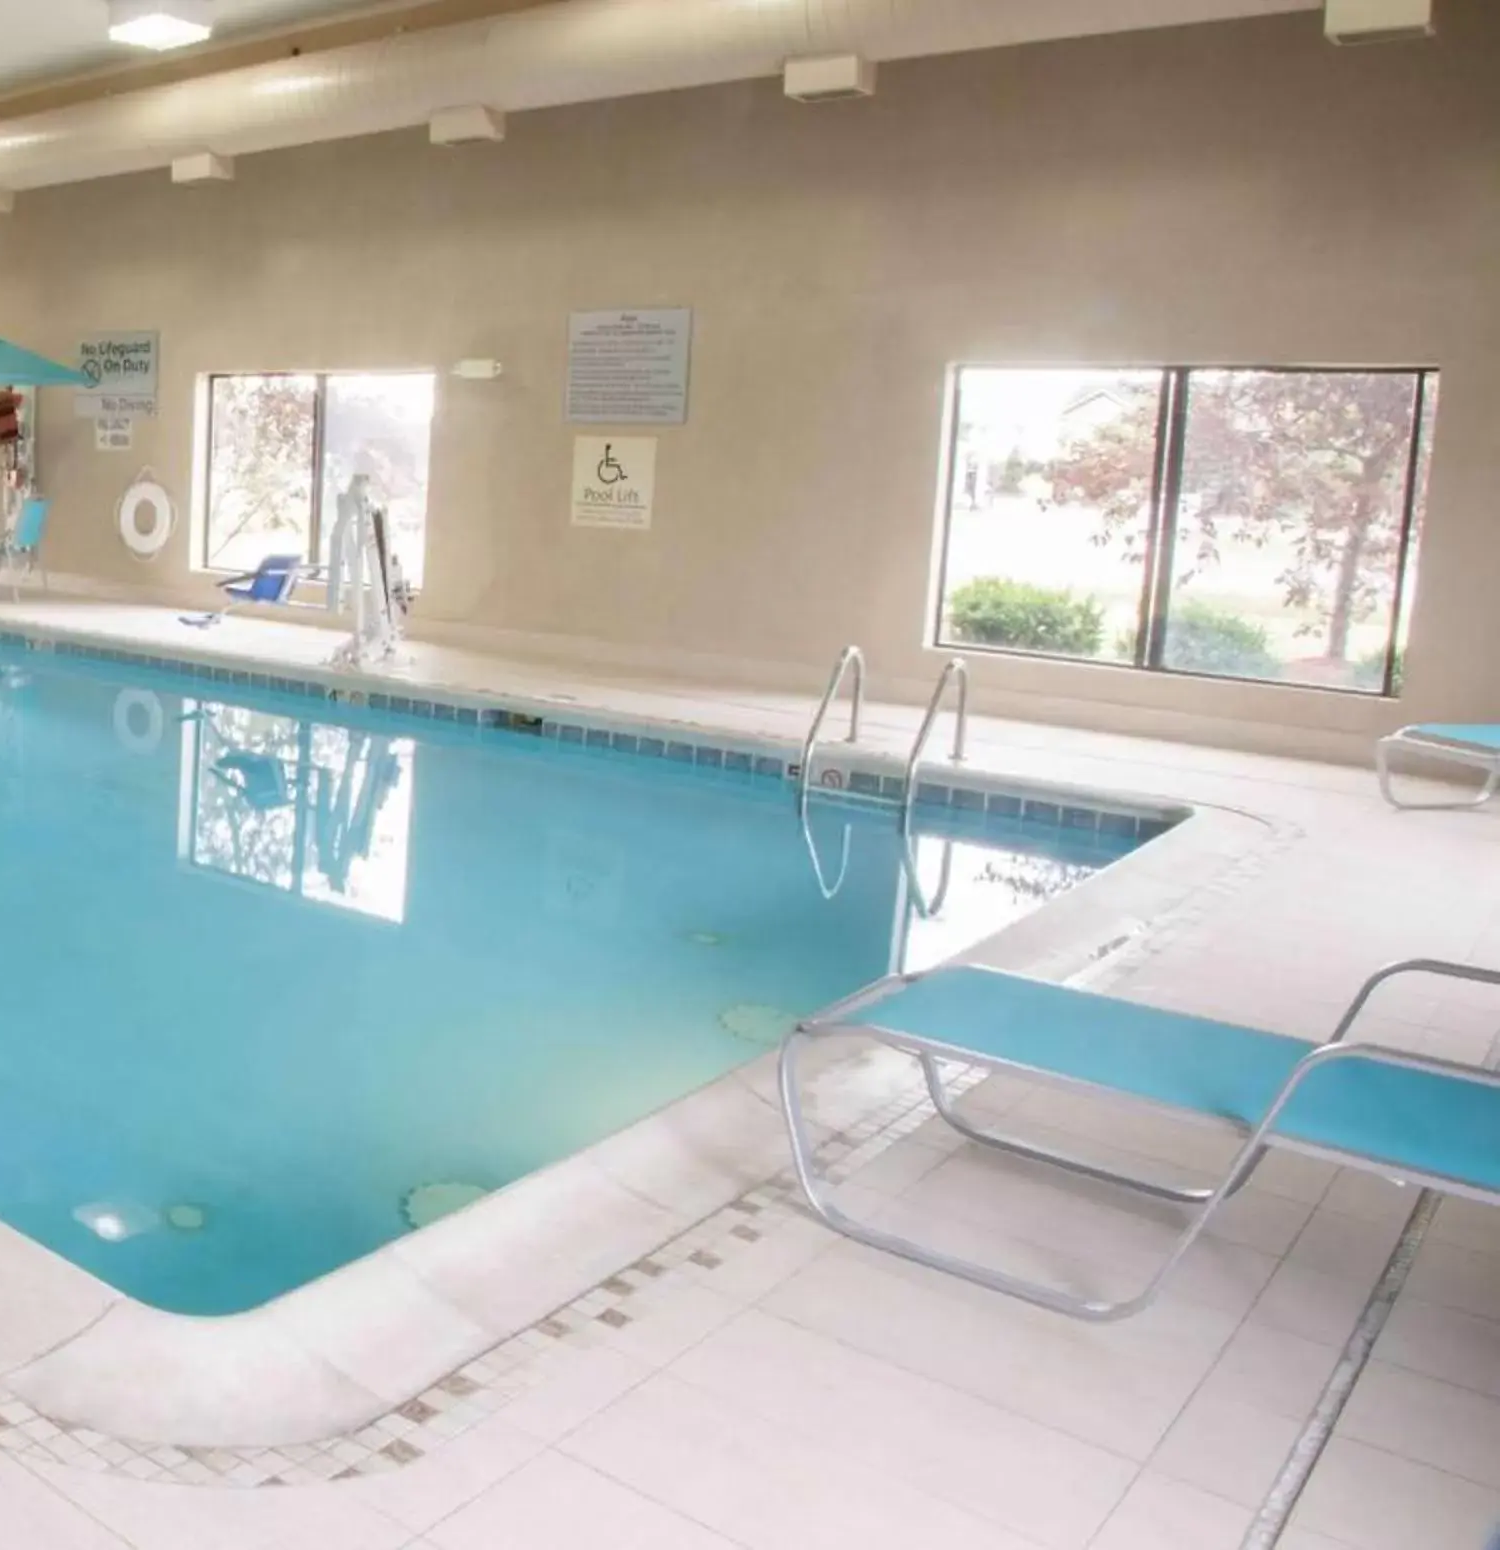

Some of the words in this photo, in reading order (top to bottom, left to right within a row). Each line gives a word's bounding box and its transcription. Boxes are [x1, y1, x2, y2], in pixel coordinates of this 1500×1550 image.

[81, 343, 96, 356] No
[98, 340, 151, 358] Lifeguard
[104, 358, 120, 373] On
[123, 358, 150, 374] Duty
[101, 397, 117, 411] No
[584, 486, 613, 502] Pool
[617, 487, 640, 503] Lift
